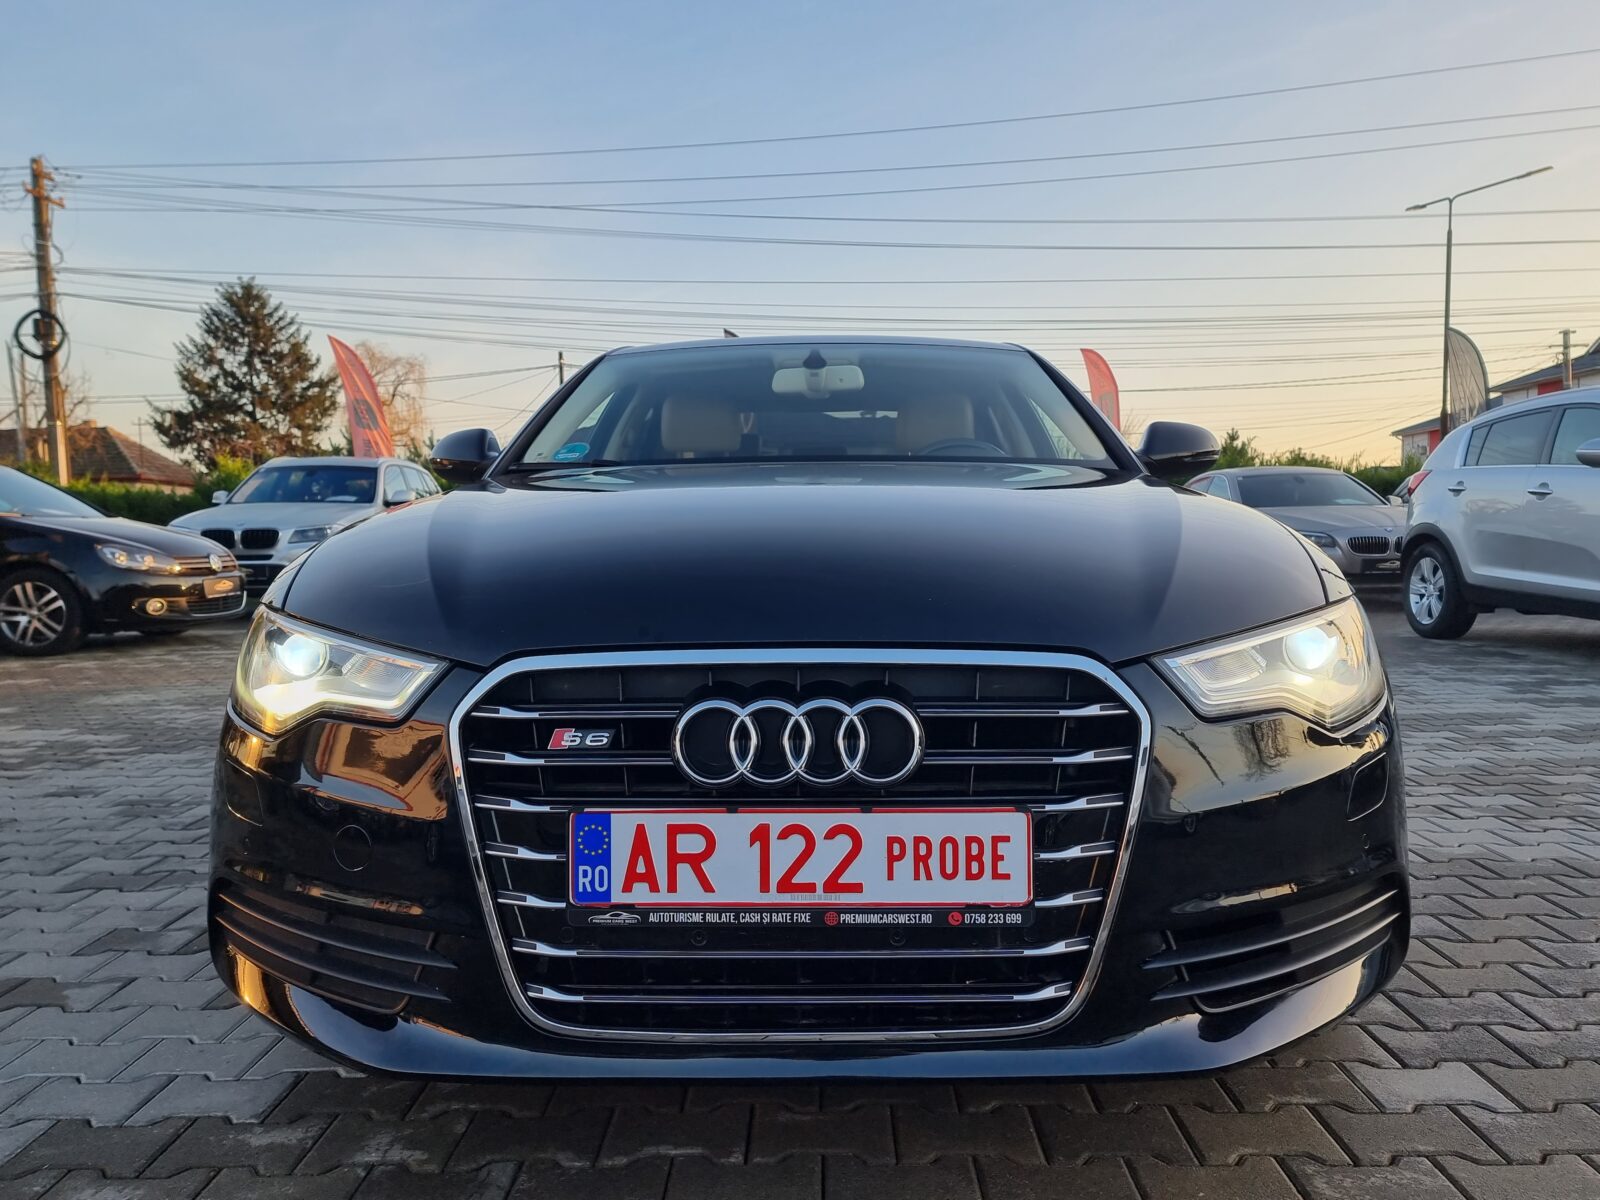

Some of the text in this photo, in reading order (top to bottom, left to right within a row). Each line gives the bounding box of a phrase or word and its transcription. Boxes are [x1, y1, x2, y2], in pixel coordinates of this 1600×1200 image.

[561, 732, 610, 746] S6
[621, 822, 1012, 894] AR 122 PROBE
[578, 865, 608, 892] RO
[648, 912, 704, 923] AUTOTURISME
[705, 912, 738, 924] RULATE,
[739, 912, 761, 923] CASH
[771, 912, 792, 923] RATE
[793, 912, 812, 923] FIXE
[840, 913, 933, 924] PREMIUMCARSWEST.RO
[964, 913, 1022, 924] 0758 233 699
